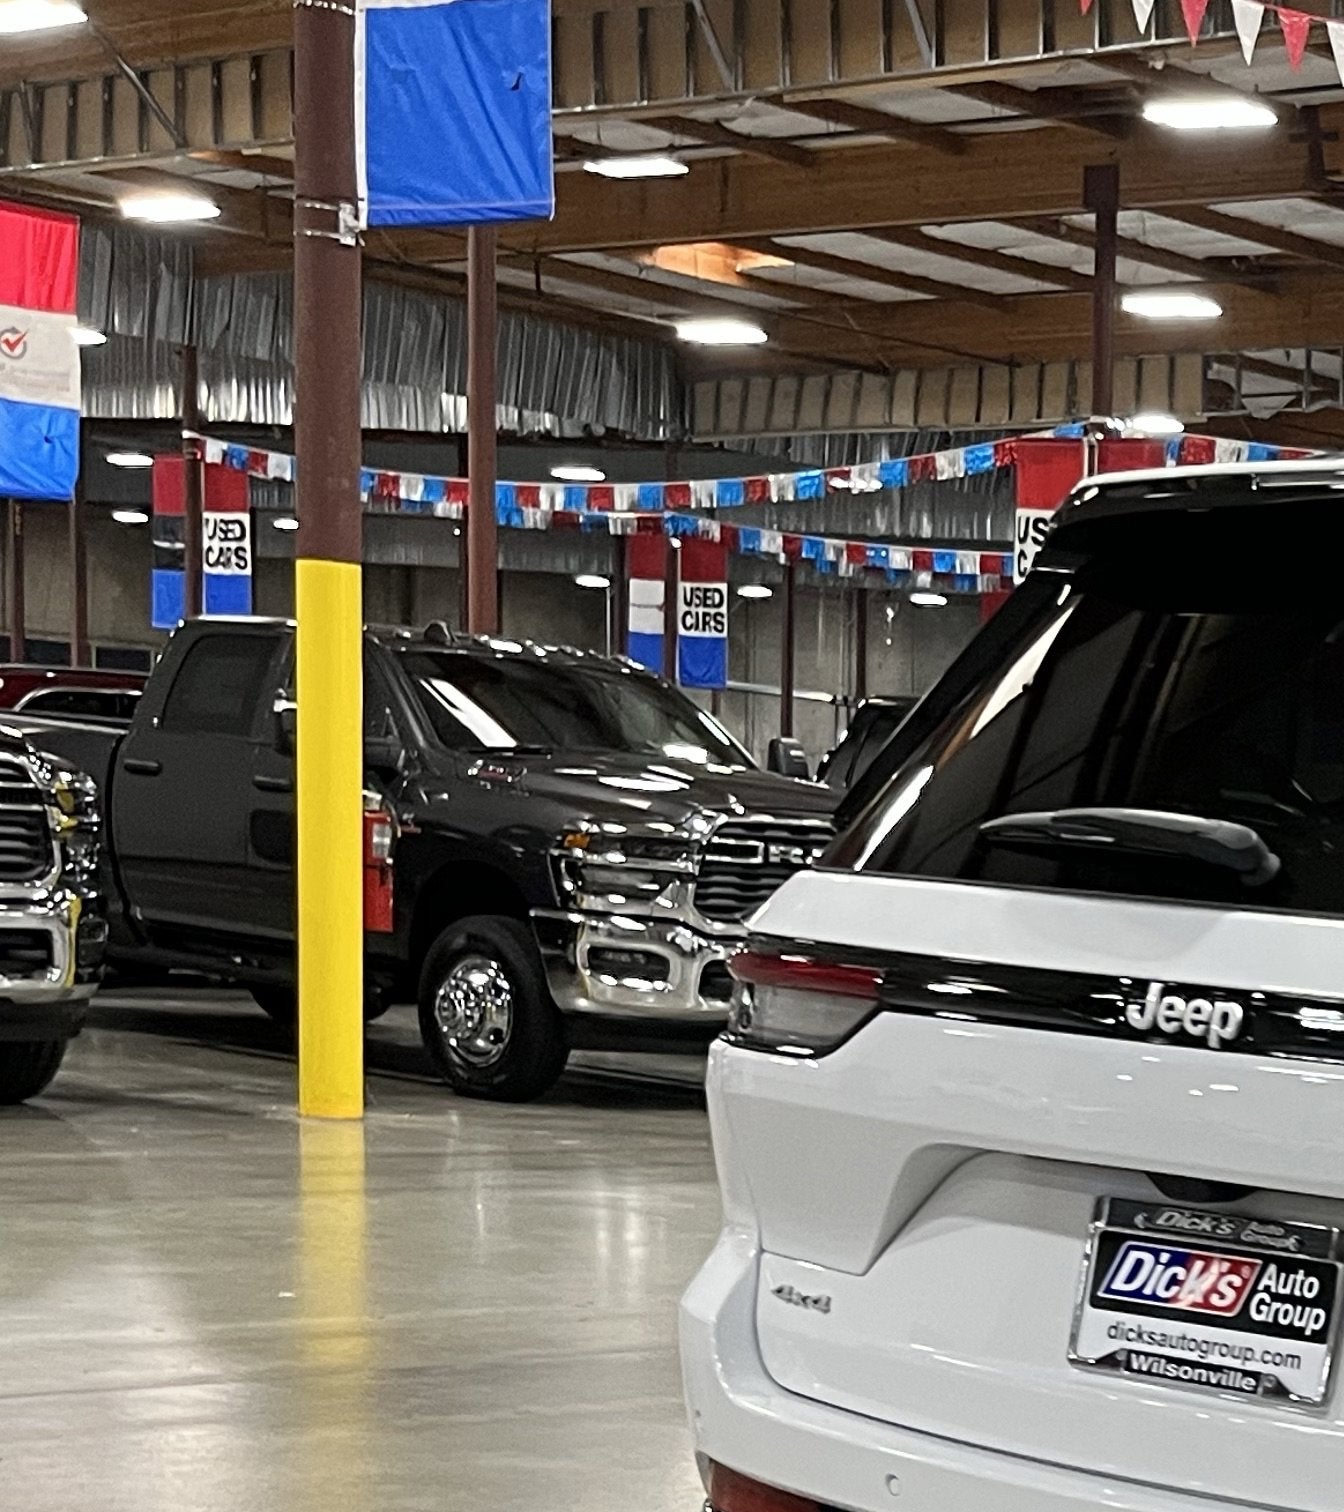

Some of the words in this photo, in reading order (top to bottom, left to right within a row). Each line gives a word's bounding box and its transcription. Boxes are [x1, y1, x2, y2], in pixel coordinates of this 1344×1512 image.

[1018, 516, 1049, 546] US
[205, 546, 248, 570] CAS
[683, 586, 725, 609] USED
[1125, 982, 1244, 1049] Jeep
[1110, 1251, 1243, 1308] Dick's
[1257, 1263, 1321, 1299] Auto
[1250, 1293, 1327, 1336] Group
[1107, 1321, 1302, 1370] dicksautogroup.com
[1129, 1352, 1258, 1392] Wilsonville
